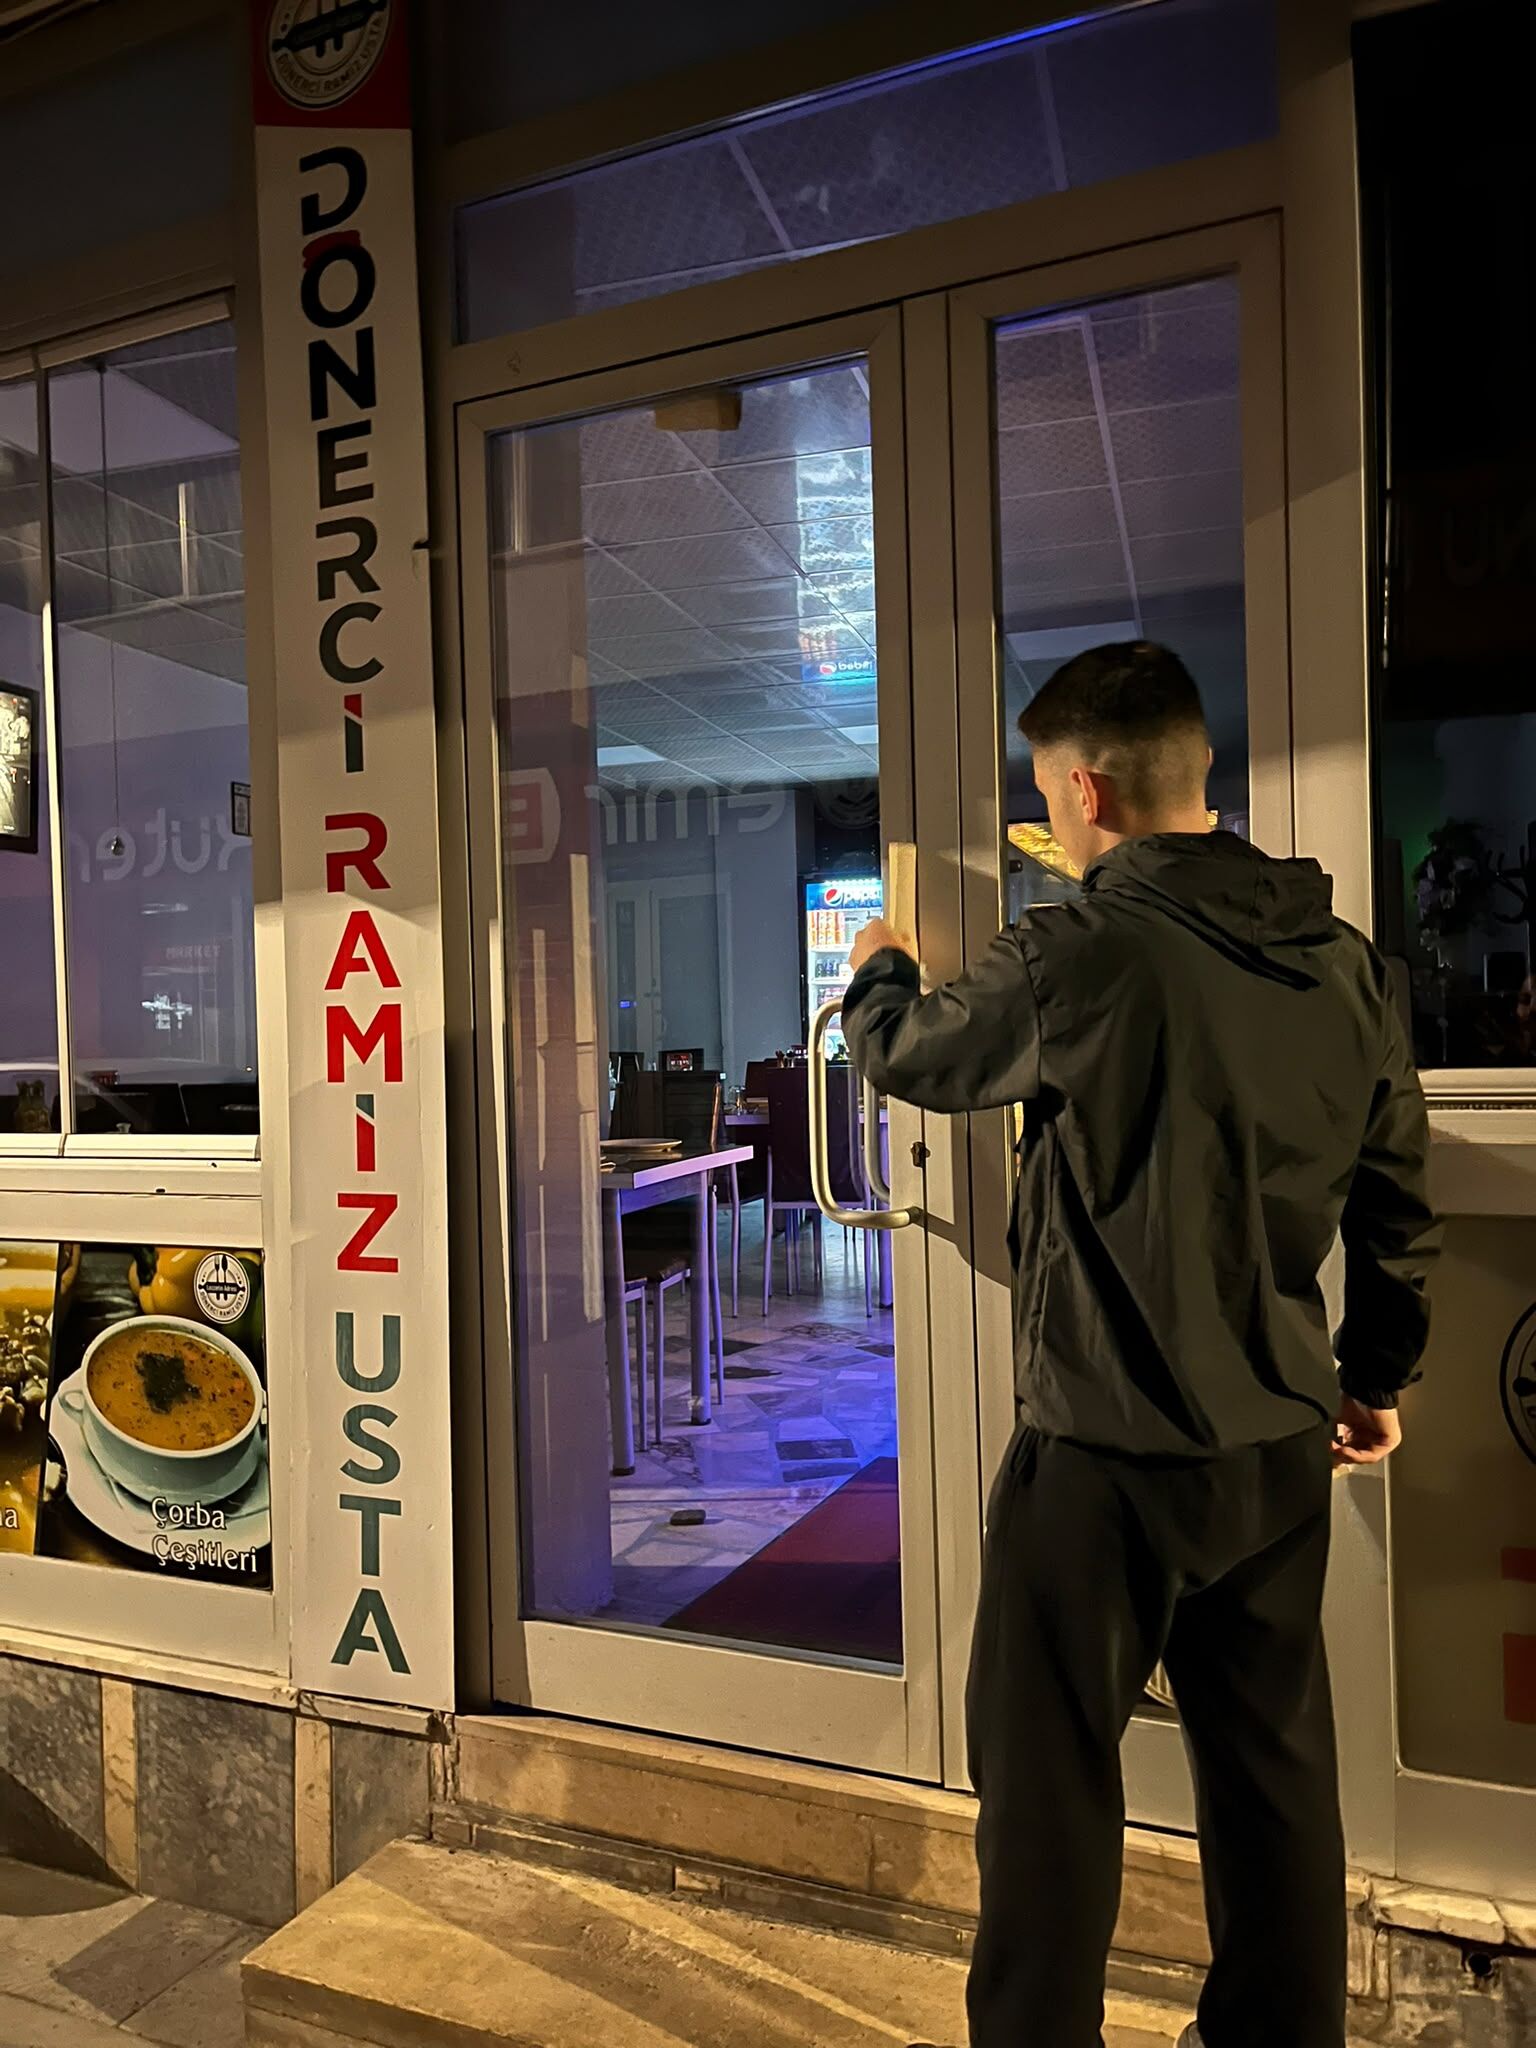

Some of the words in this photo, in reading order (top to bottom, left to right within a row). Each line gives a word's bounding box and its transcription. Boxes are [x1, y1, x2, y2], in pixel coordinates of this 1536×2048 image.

[331, 1311, 412, 1675] USTA
[151, 1496, 227, 1530] Çorba
[151, 1535, 258, 1573] Çeşitleri
